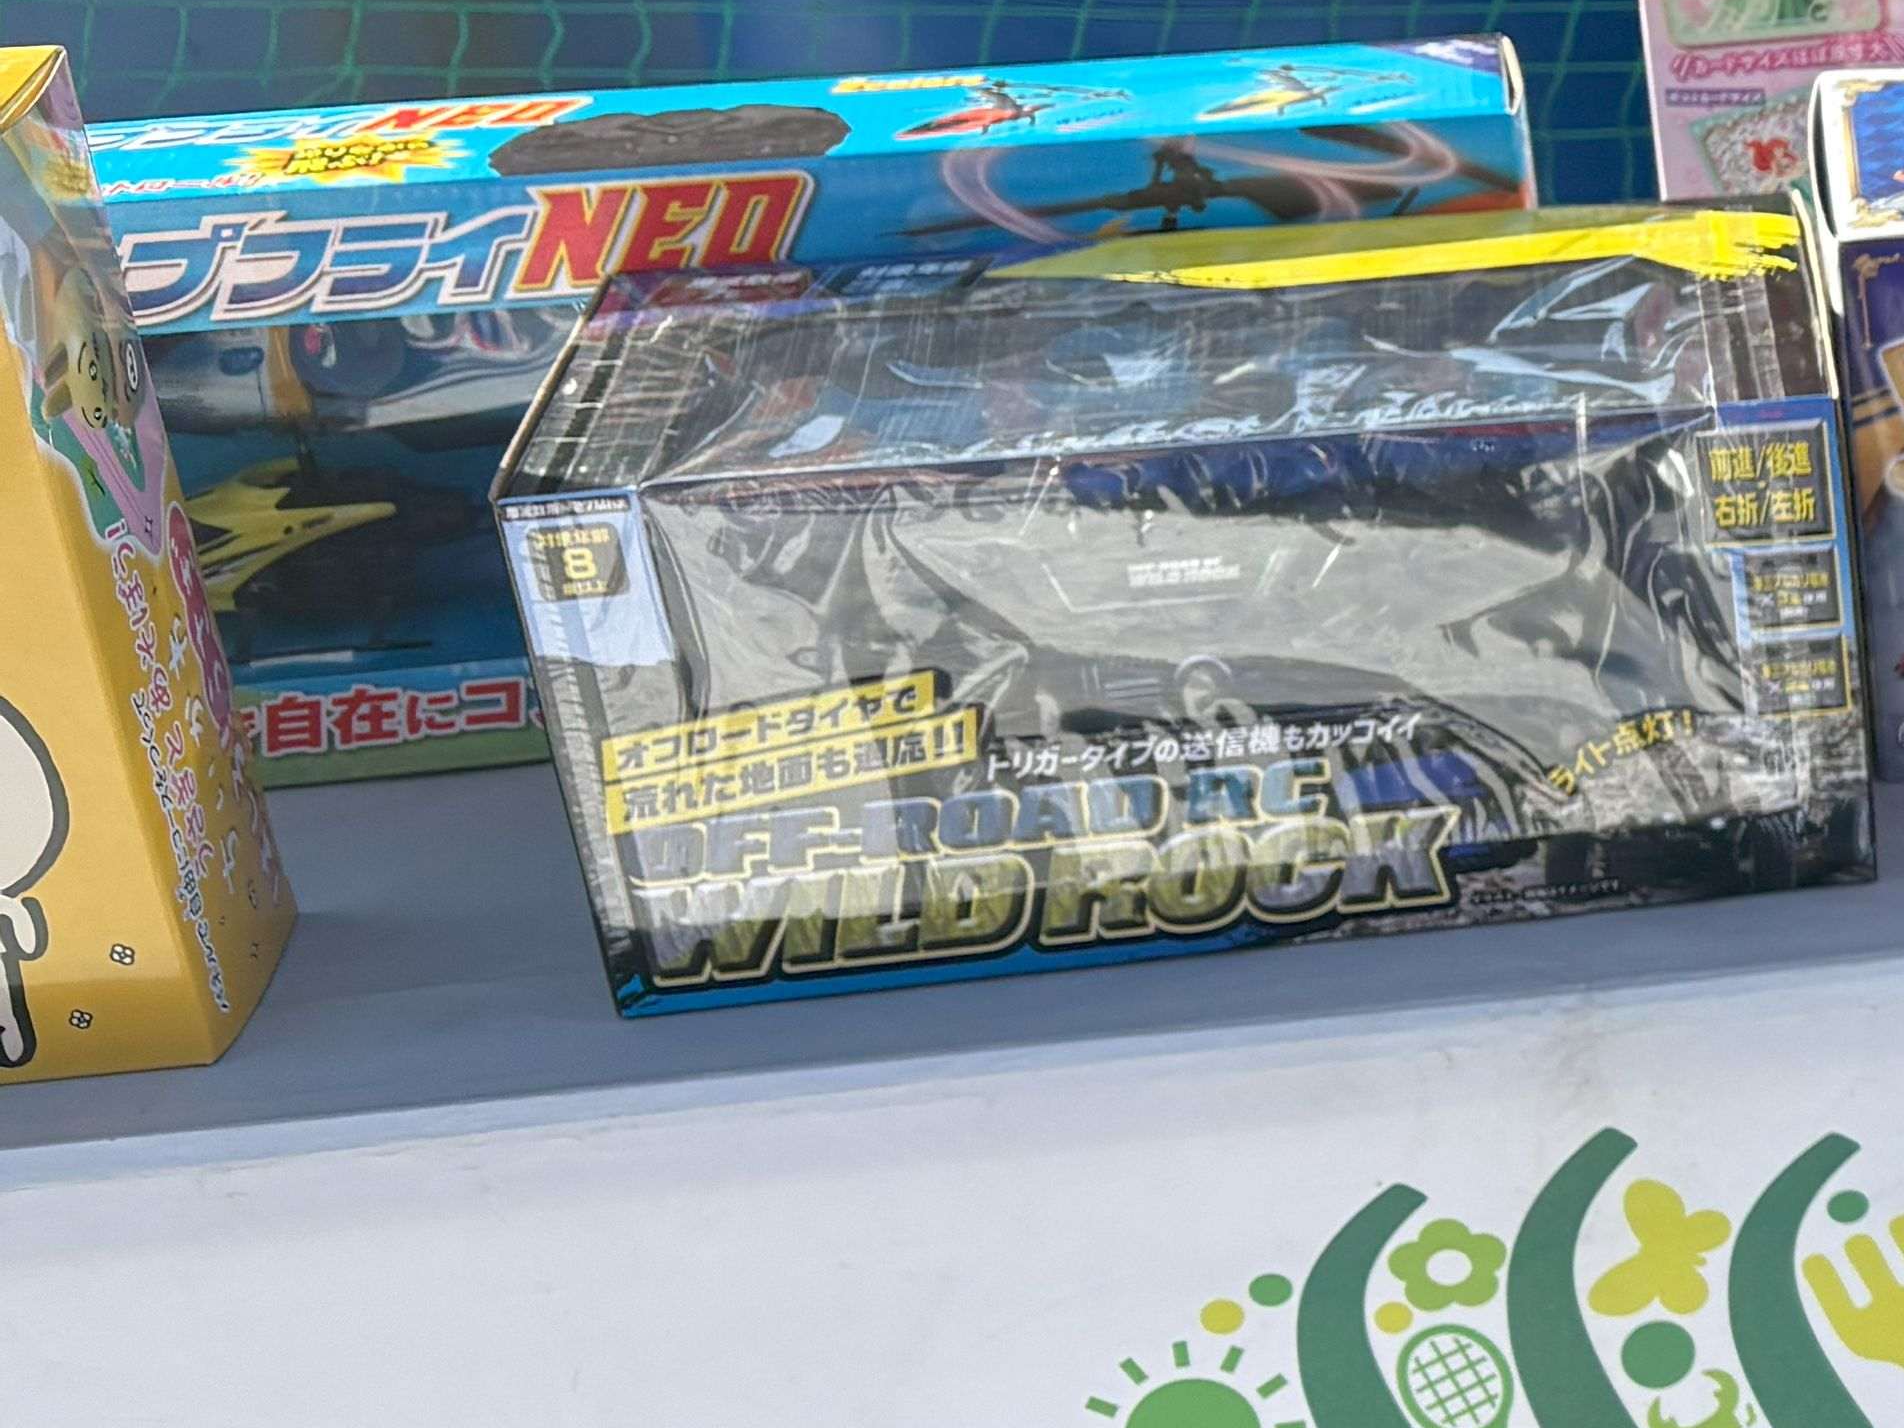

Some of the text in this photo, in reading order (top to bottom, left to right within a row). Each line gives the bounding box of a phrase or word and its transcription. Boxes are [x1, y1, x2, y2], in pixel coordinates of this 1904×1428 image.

[1708, 441, 1813, 482] 前進/後進
[1714, 488, 1817, 528] 右折/左折
[562, 547, 598, 580] 8
[238, 676, 546, 760] 自在にコ
[618, 683, 918, 770] オフロードタイヤで
[987, 712, 1423, 782] トリガータイプの送信機もカッコイイ
[1547, 708, 1695, 797] ライト点灯!
[628, 757, 1331, 887] OFF-ROAD RC
[632, 805, 1461, 988] WILD ROCK
